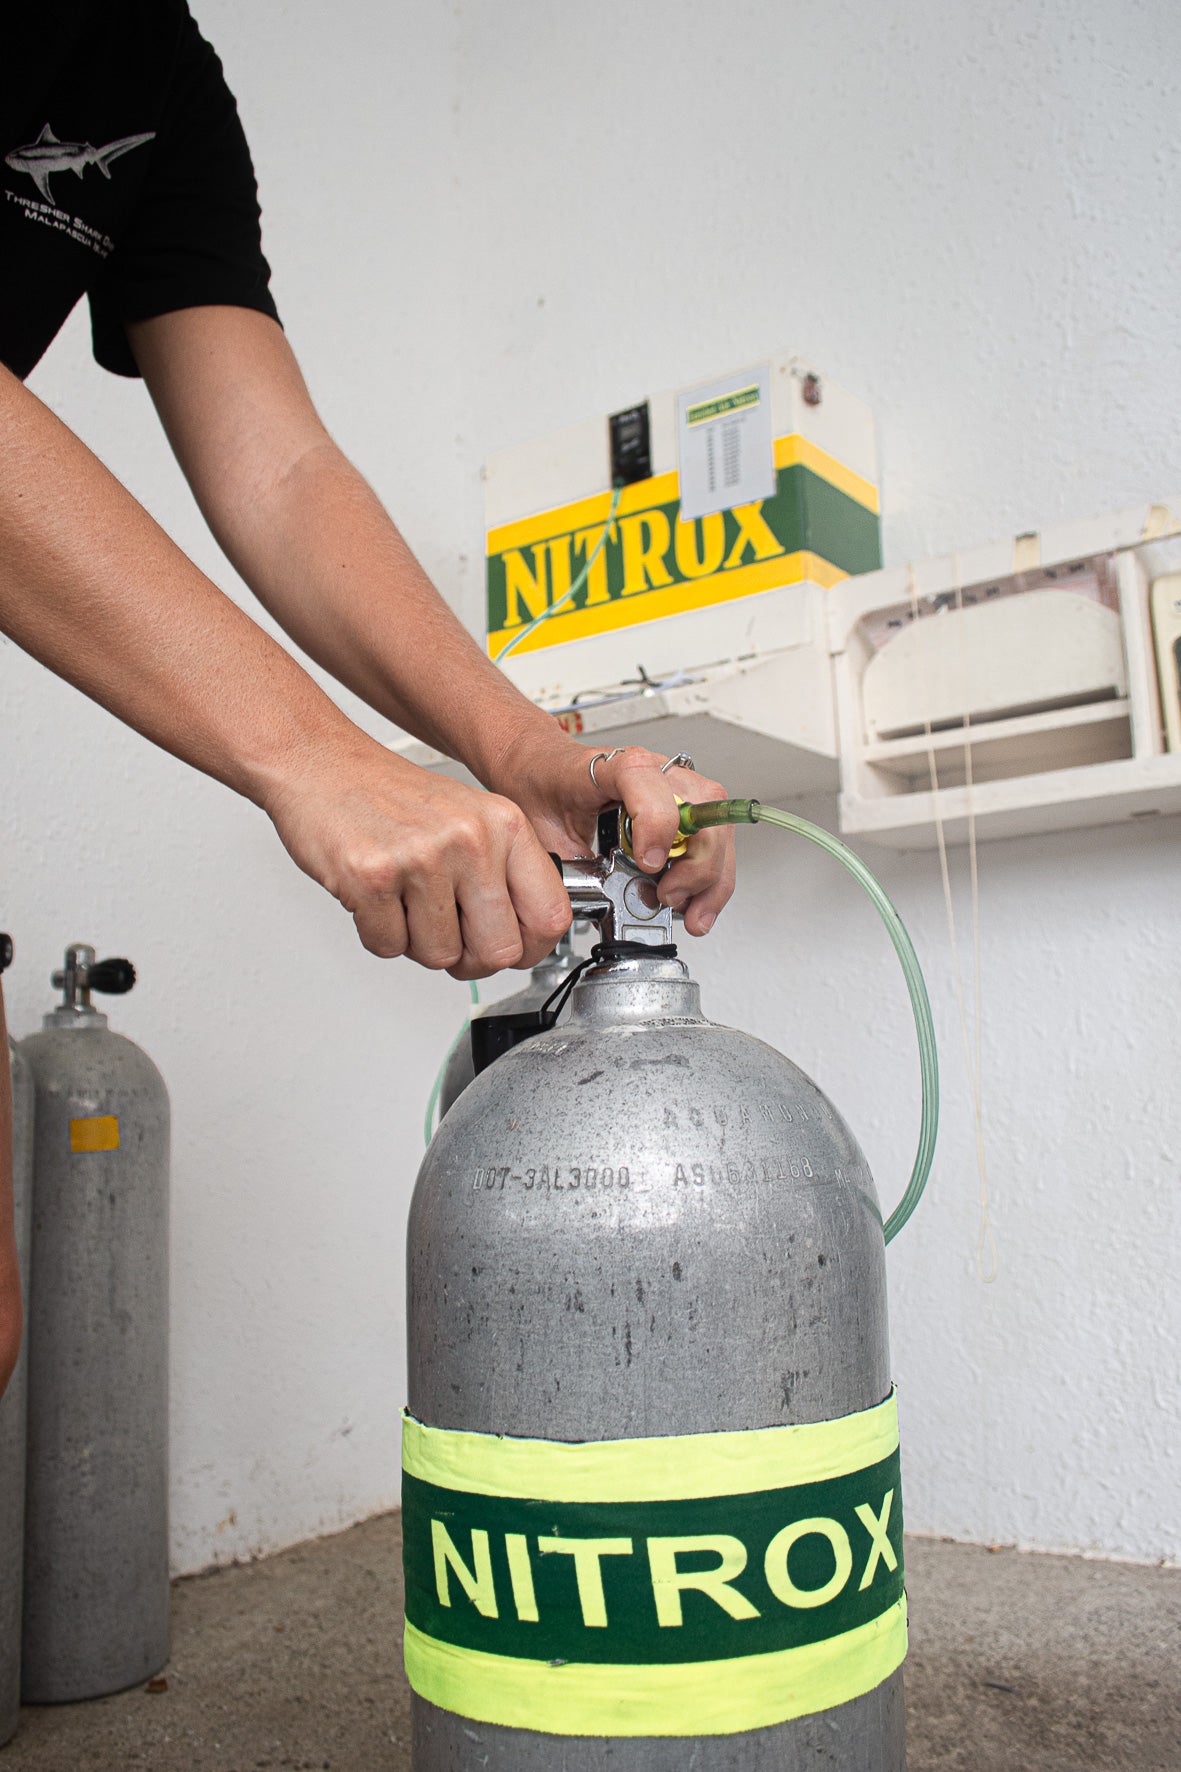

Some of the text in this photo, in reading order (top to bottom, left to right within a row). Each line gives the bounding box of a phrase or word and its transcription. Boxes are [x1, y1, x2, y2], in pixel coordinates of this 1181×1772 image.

[5, 189, 70, 223] THRESHER
[502, 499, 786, 629] NITROX
[430, 1487, 898, 1628] NITROX
